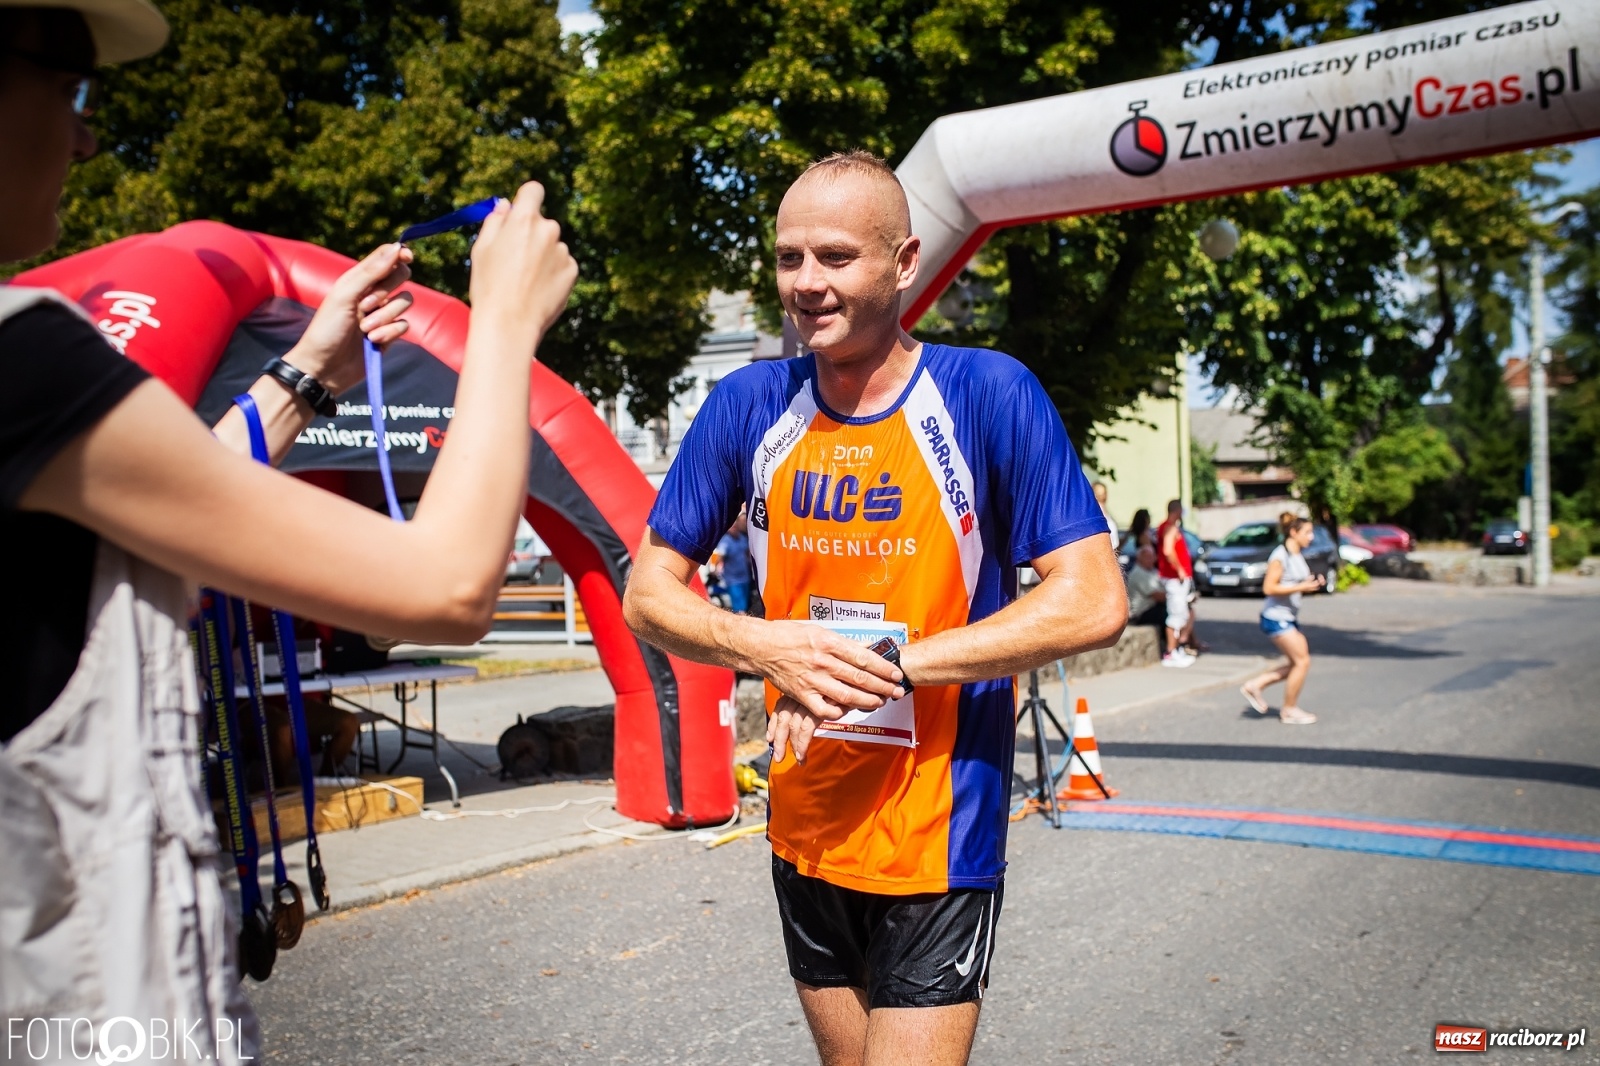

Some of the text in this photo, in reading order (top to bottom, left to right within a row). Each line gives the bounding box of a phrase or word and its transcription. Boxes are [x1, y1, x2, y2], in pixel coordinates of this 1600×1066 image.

[1182, 12, 1561, 99] Elektroniczny pomiar czasu
[1176, 47, 1581, 161] ZmierzymyCzas.pl
[388, 403, 440, 420] pomiar
[790, 469, 859, 523] ULC
[755, 501, 767, 527] ACP
[780, 532, 917, 556] LANGENLOIS
[836, 606, 881, 619] Ursin Haus
